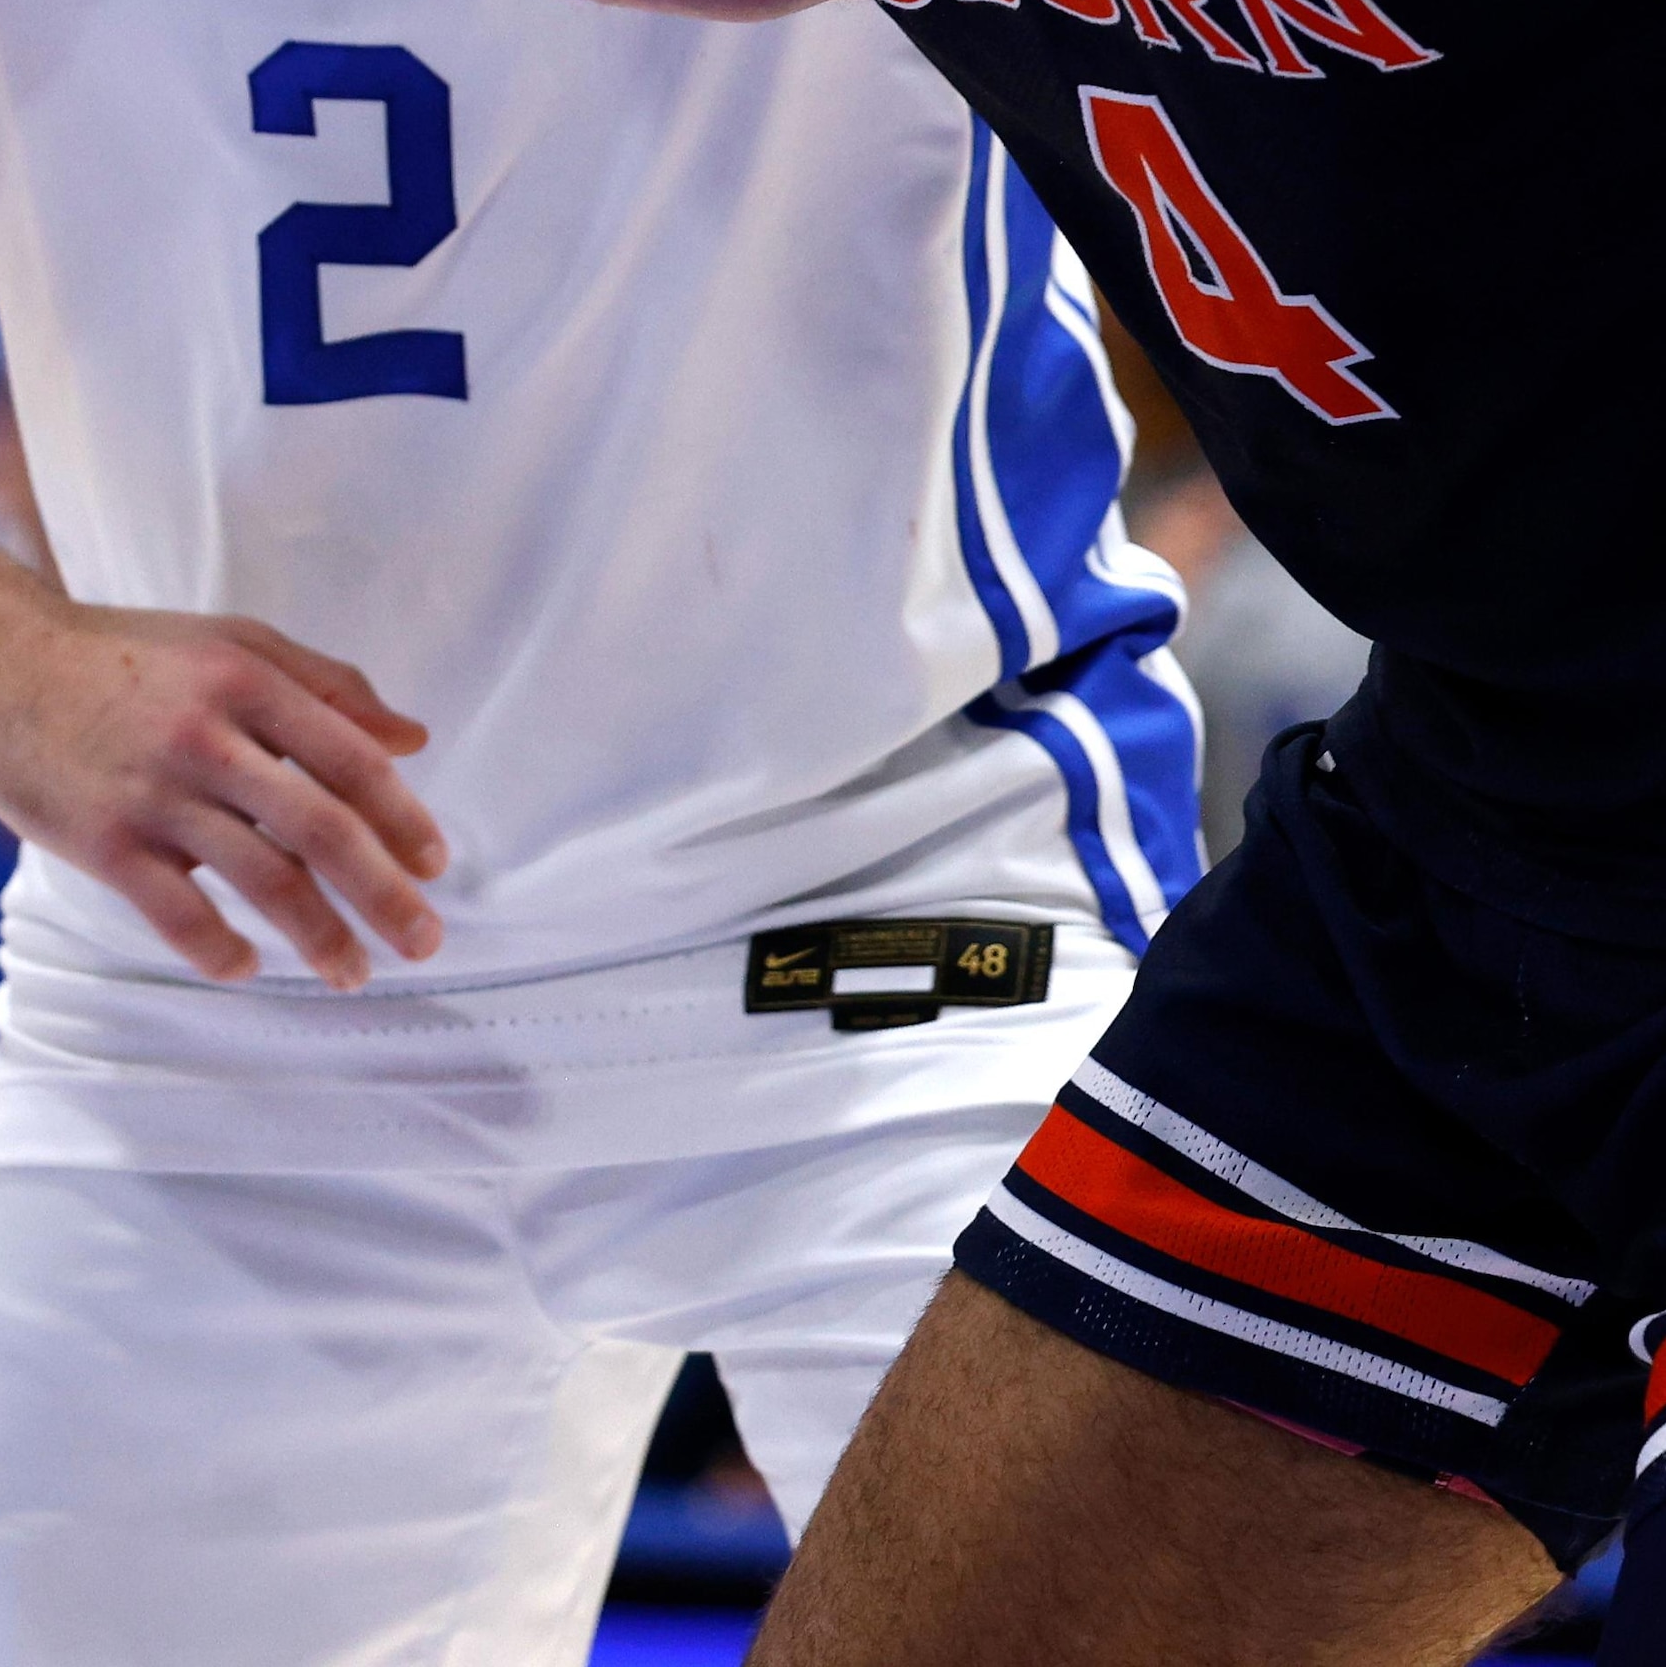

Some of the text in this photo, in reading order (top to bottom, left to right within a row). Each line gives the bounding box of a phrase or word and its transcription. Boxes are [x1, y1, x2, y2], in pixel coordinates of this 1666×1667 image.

[247, 40, 469, 407] 2
[1079, 84, 1400, 426] 4
[956, 942, 1008, 979] 48
